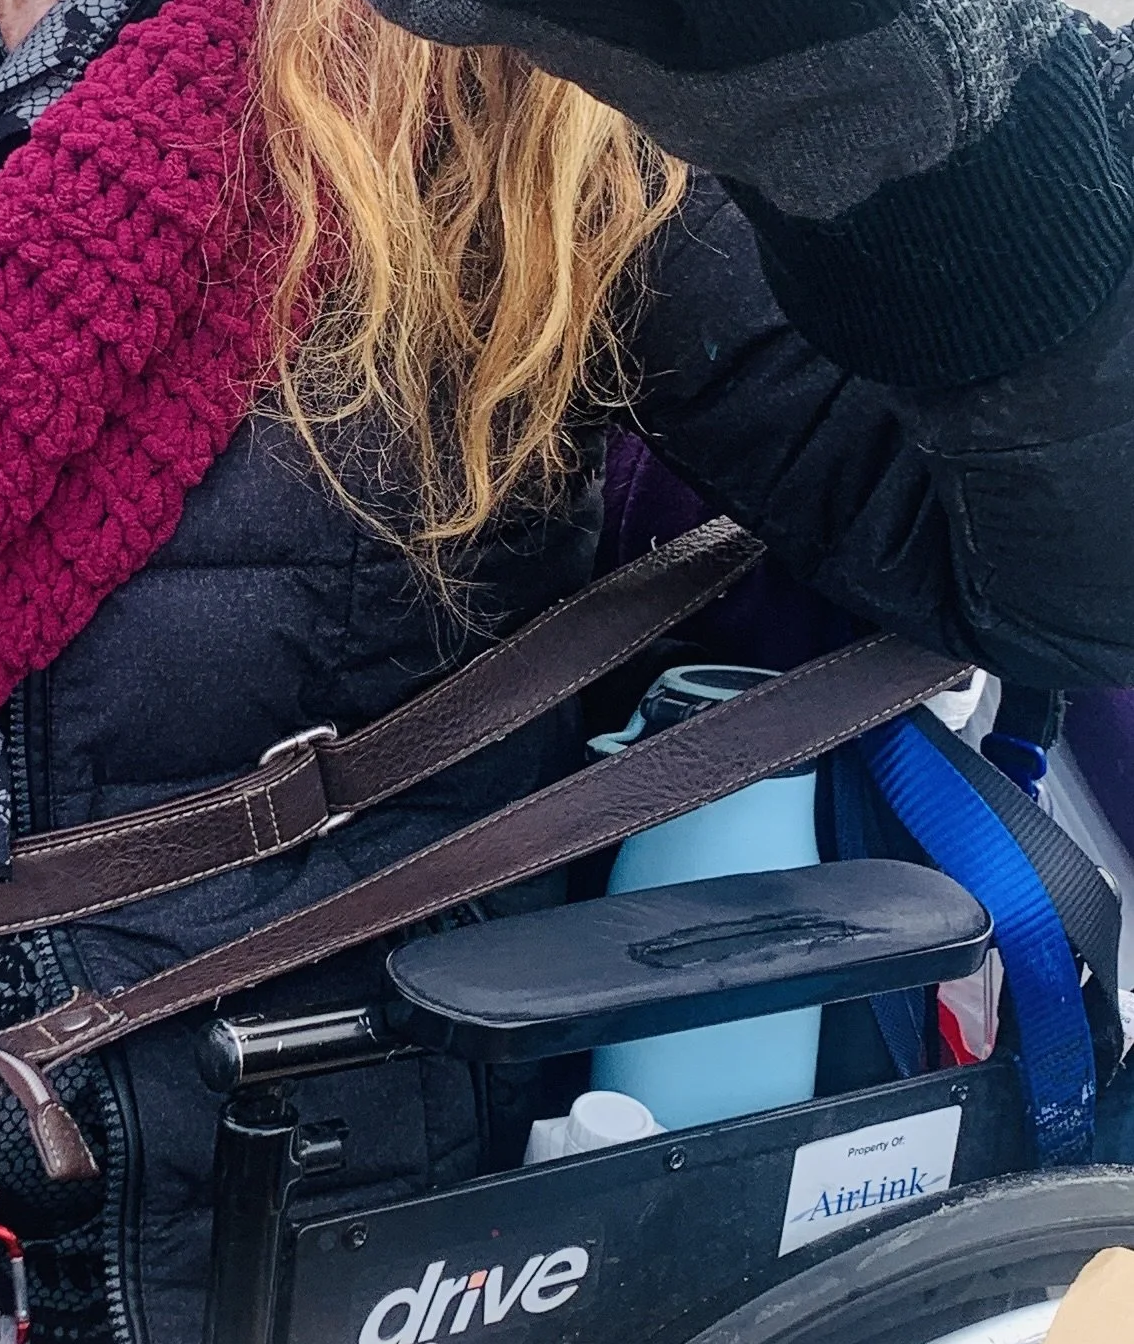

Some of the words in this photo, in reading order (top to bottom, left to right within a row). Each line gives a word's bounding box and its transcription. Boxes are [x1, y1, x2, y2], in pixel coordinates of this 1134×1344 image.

[847, 1141, 889, 1158] Property
[891, 1135, 906, 1147] Of:
[808, 1167, 928, 1221] AirLink
